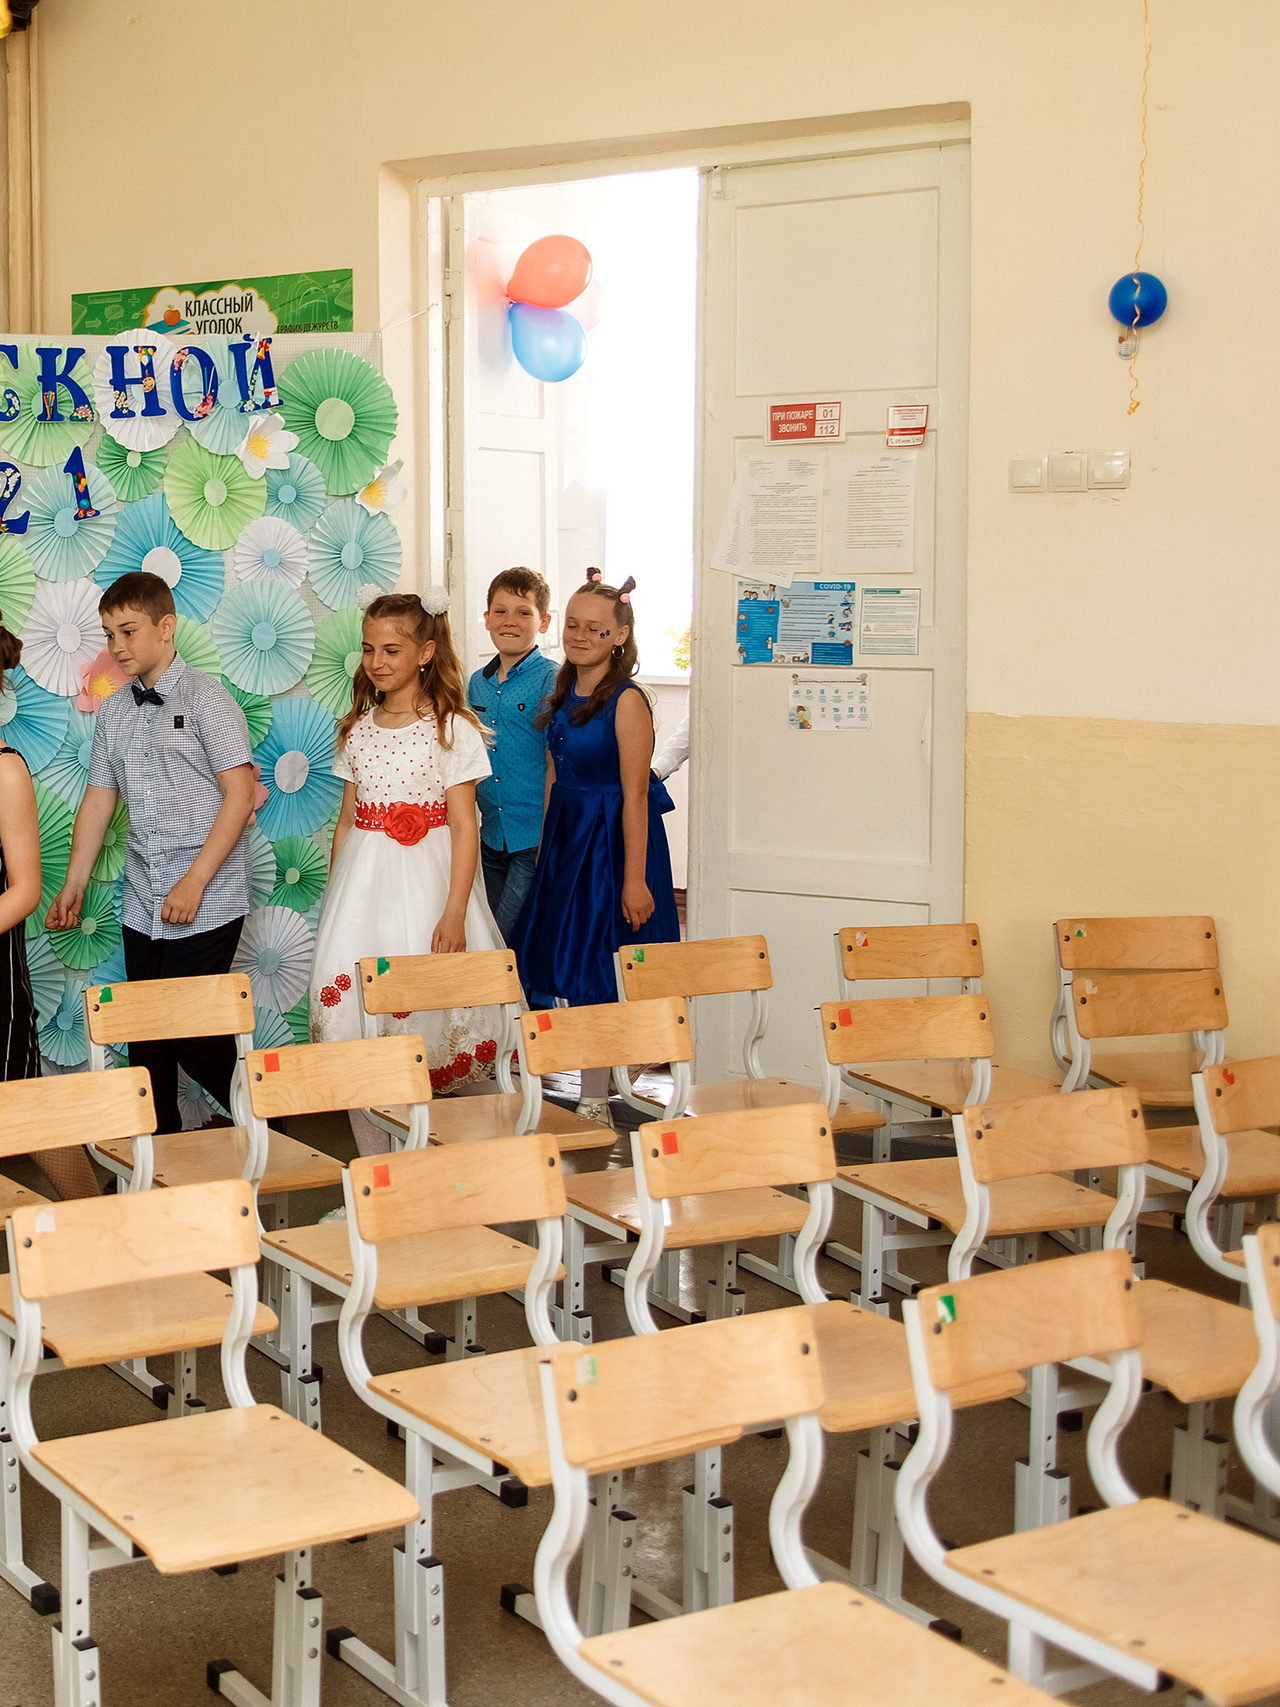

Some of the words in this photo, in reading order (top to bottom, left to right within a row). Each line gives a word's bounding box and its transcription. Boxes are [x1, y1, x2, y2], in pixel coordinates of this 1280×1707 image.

[185, 292, 253, 317] КЛАССНЫЙ
[195, 317, 243, 335] УГОЛОК
[772, 411, 786, 421] ПРИ
[786, 409, 814, 421] ПОЖАРЕ
[822, 408, 834, 419] 01
[777, 422, 808, 433] ЗВОНИТЬ
[819, 424, 836, 435] 112
[819, 582, 852, 591] COVID-19
